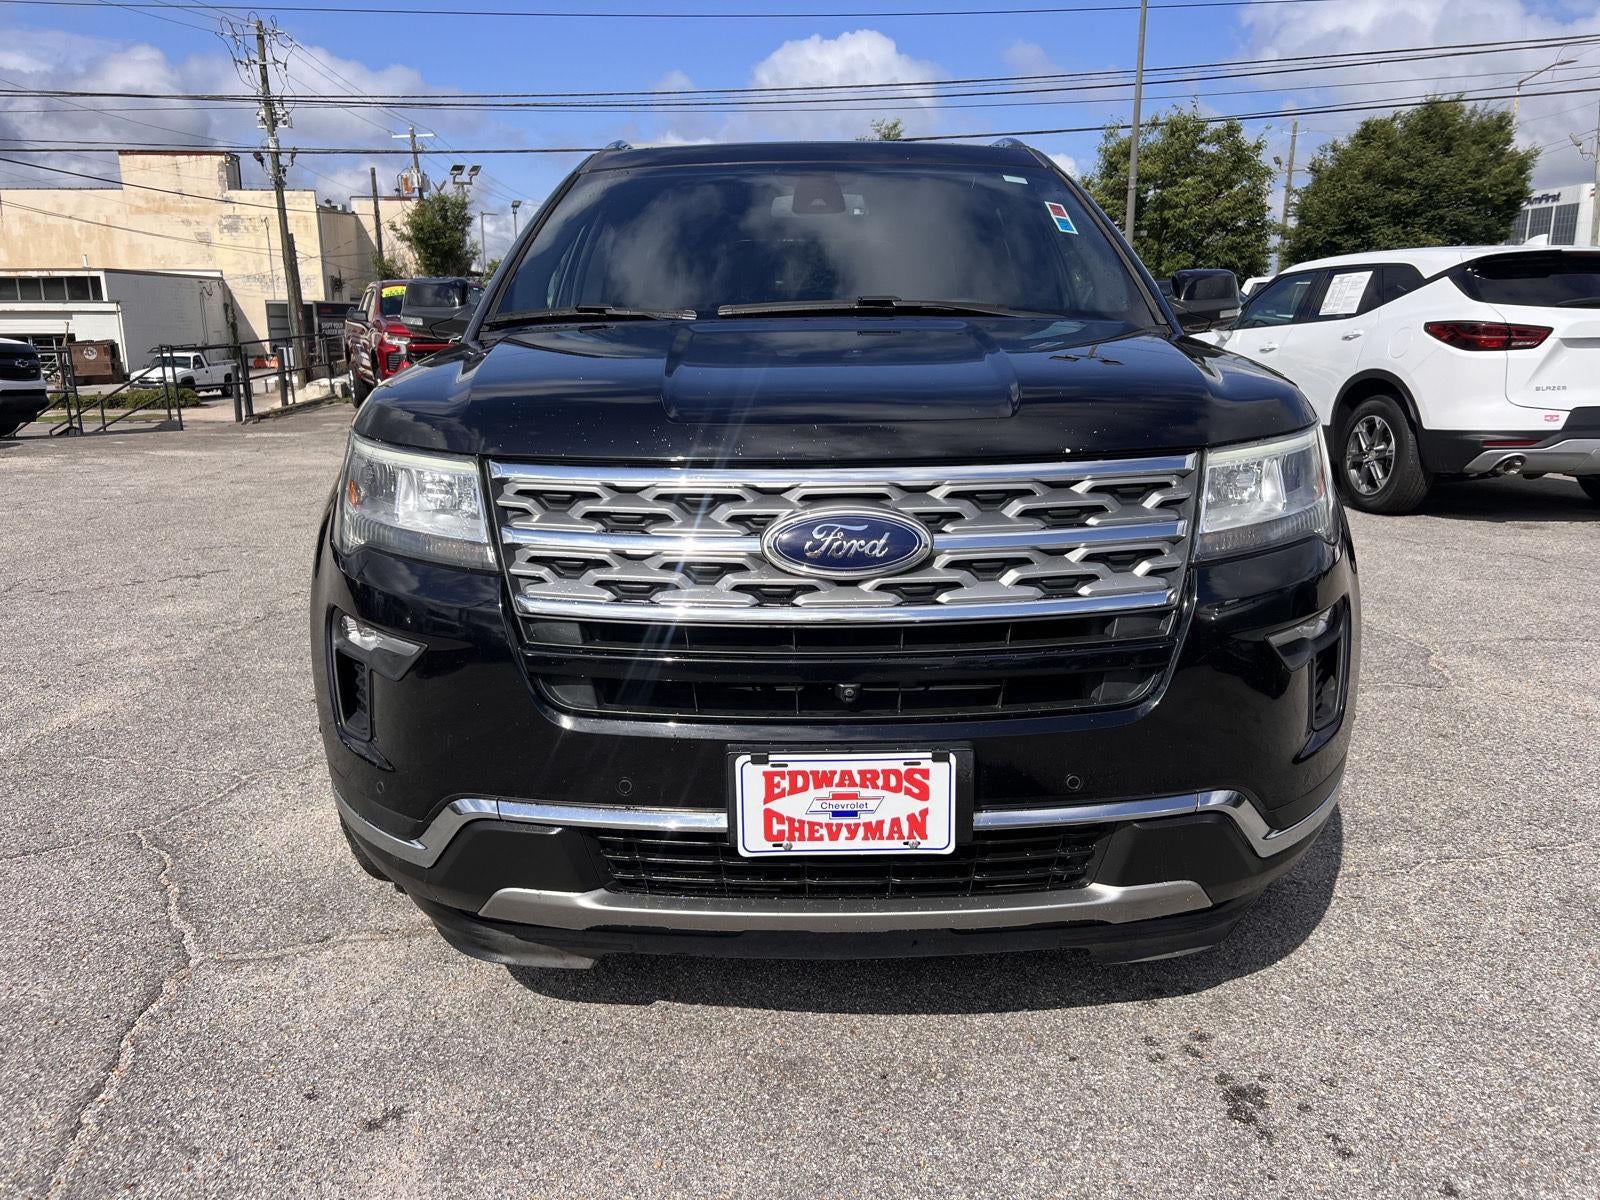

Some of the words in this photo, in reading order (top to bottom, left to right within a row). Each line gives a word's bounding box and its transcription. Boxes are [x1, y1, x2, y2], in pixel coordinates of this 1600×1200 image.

[804, 523, 890, 558] Ford
[762, 768, 930, 805] EDWARDS
[820, 801, 869, 810] Chevrolet
[763, 807, 929, 842] CHEVYMAN
